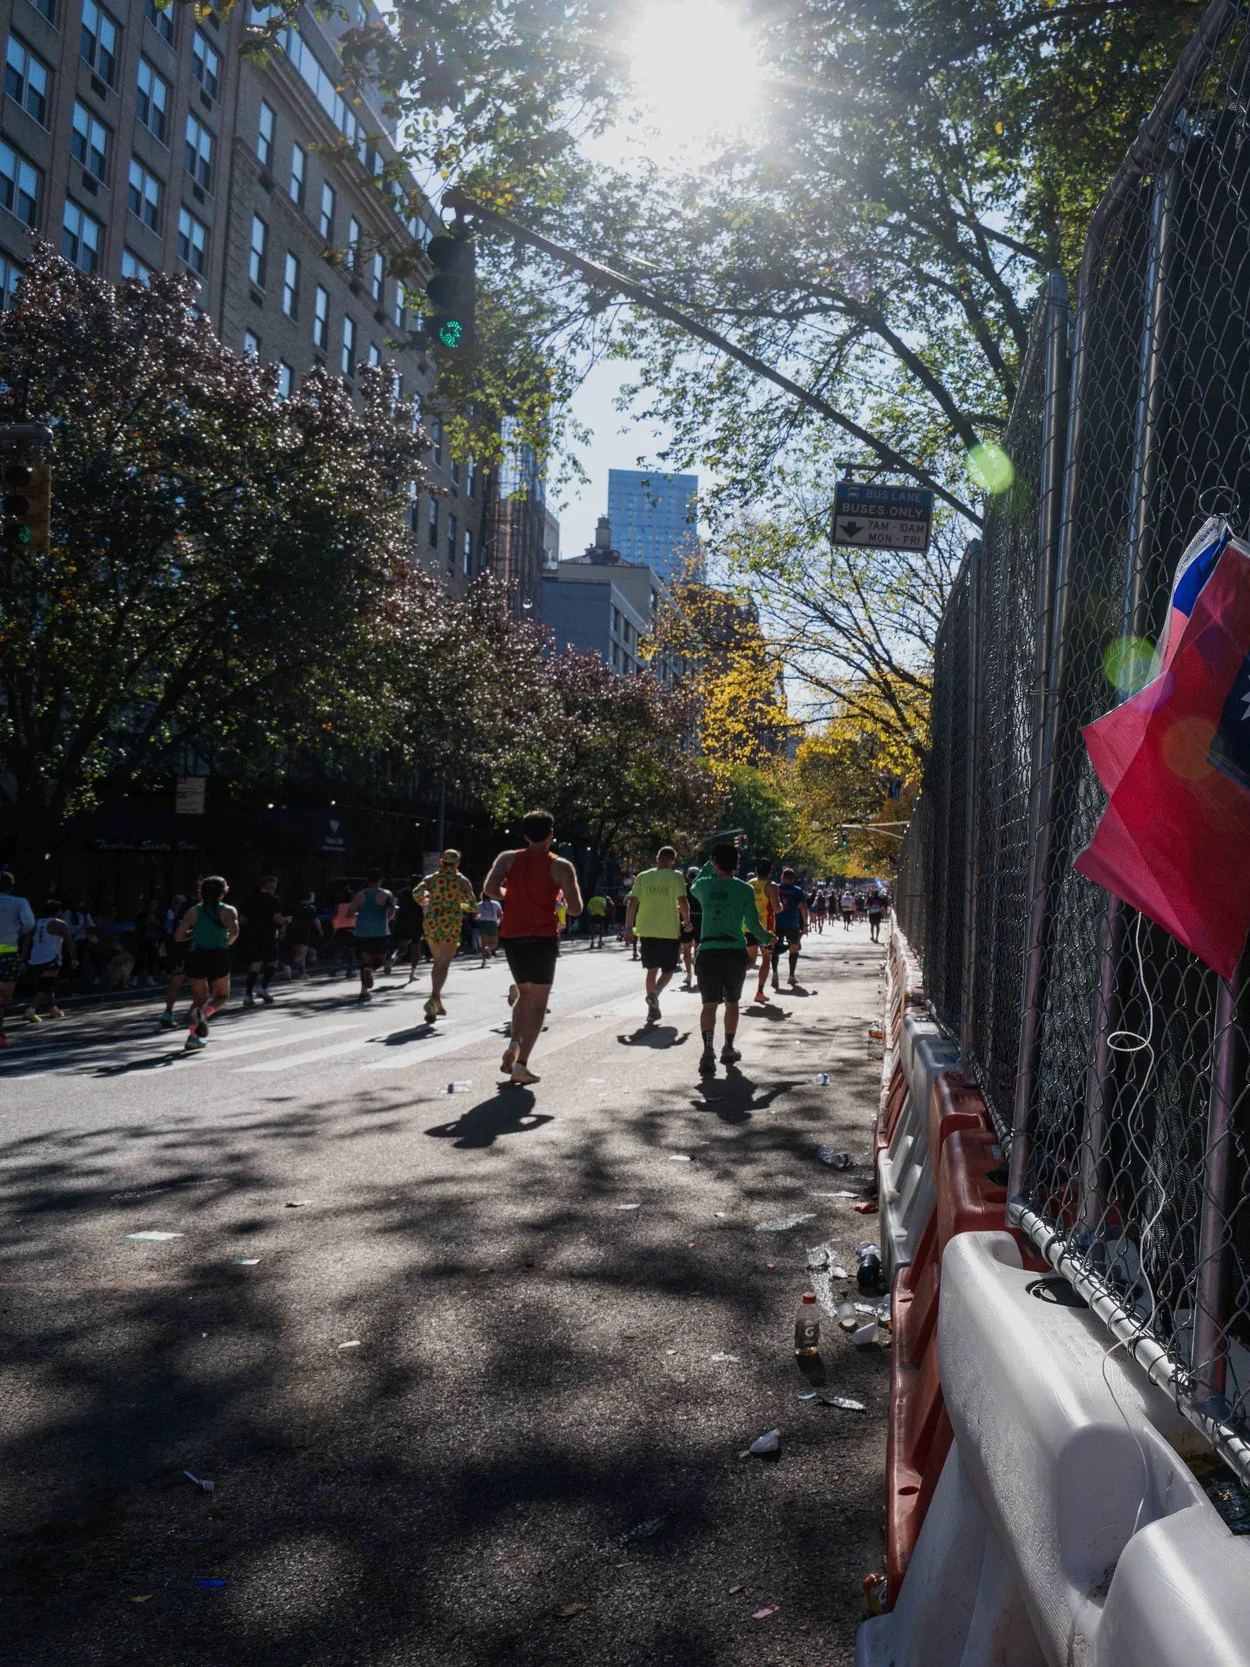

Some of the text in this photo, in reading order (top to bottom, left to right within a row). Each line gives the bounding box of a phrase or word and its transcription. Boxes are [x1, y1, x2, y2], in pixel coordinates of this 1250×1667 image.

[865, 489, 922, 503] BUS LANE
[842, 502, 924, 518] BUSES ONLY
[867, 520, 889, 531] 7AM
[899, 522, 925, 534] 10AM
[868, 533, 892, 544] MON
[903, 535, 921, 546] FRI
